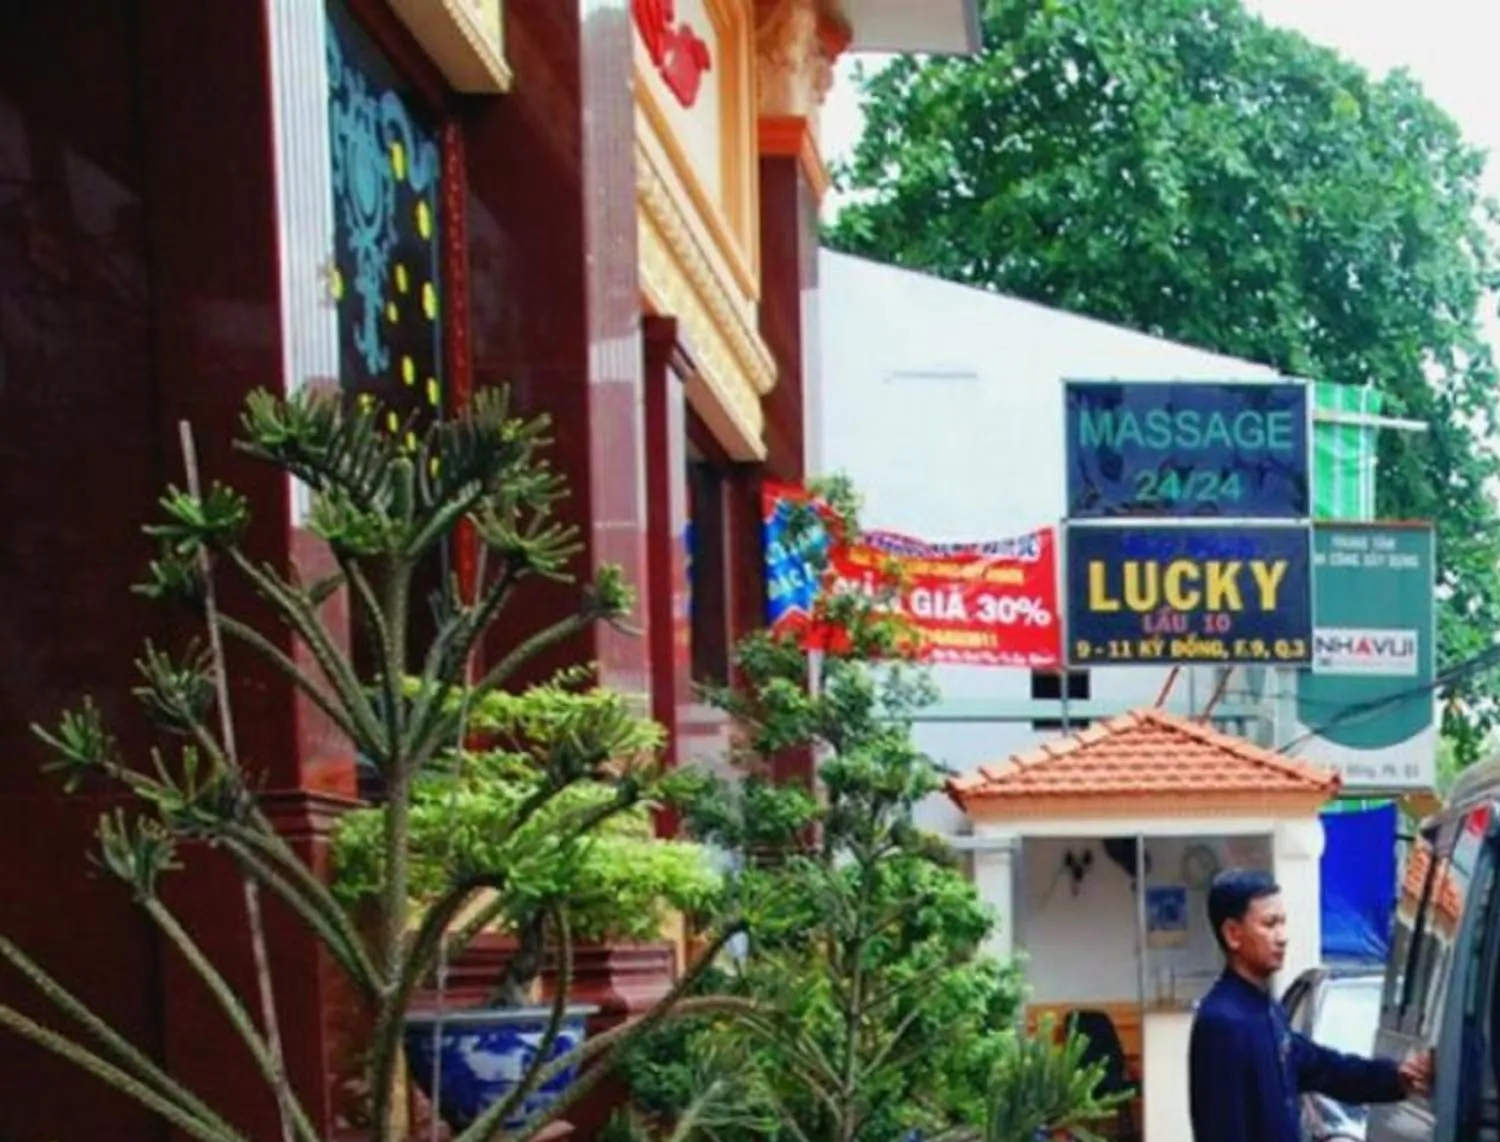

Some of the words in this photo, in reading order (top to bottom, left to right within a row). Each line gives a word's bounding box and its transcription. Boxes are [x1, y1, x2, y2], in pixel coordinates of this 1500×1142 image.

[1079, 409, 1294, 450] MASSAGE
[1135, 469, 1244, 501] 24/24
[911, 584, 967, 620] GIÁ
[976, 592, 1052, 627] 30%
[1088, 559, 1288, 612] LUCKY
[1202, 612, 1232, 634] 10
